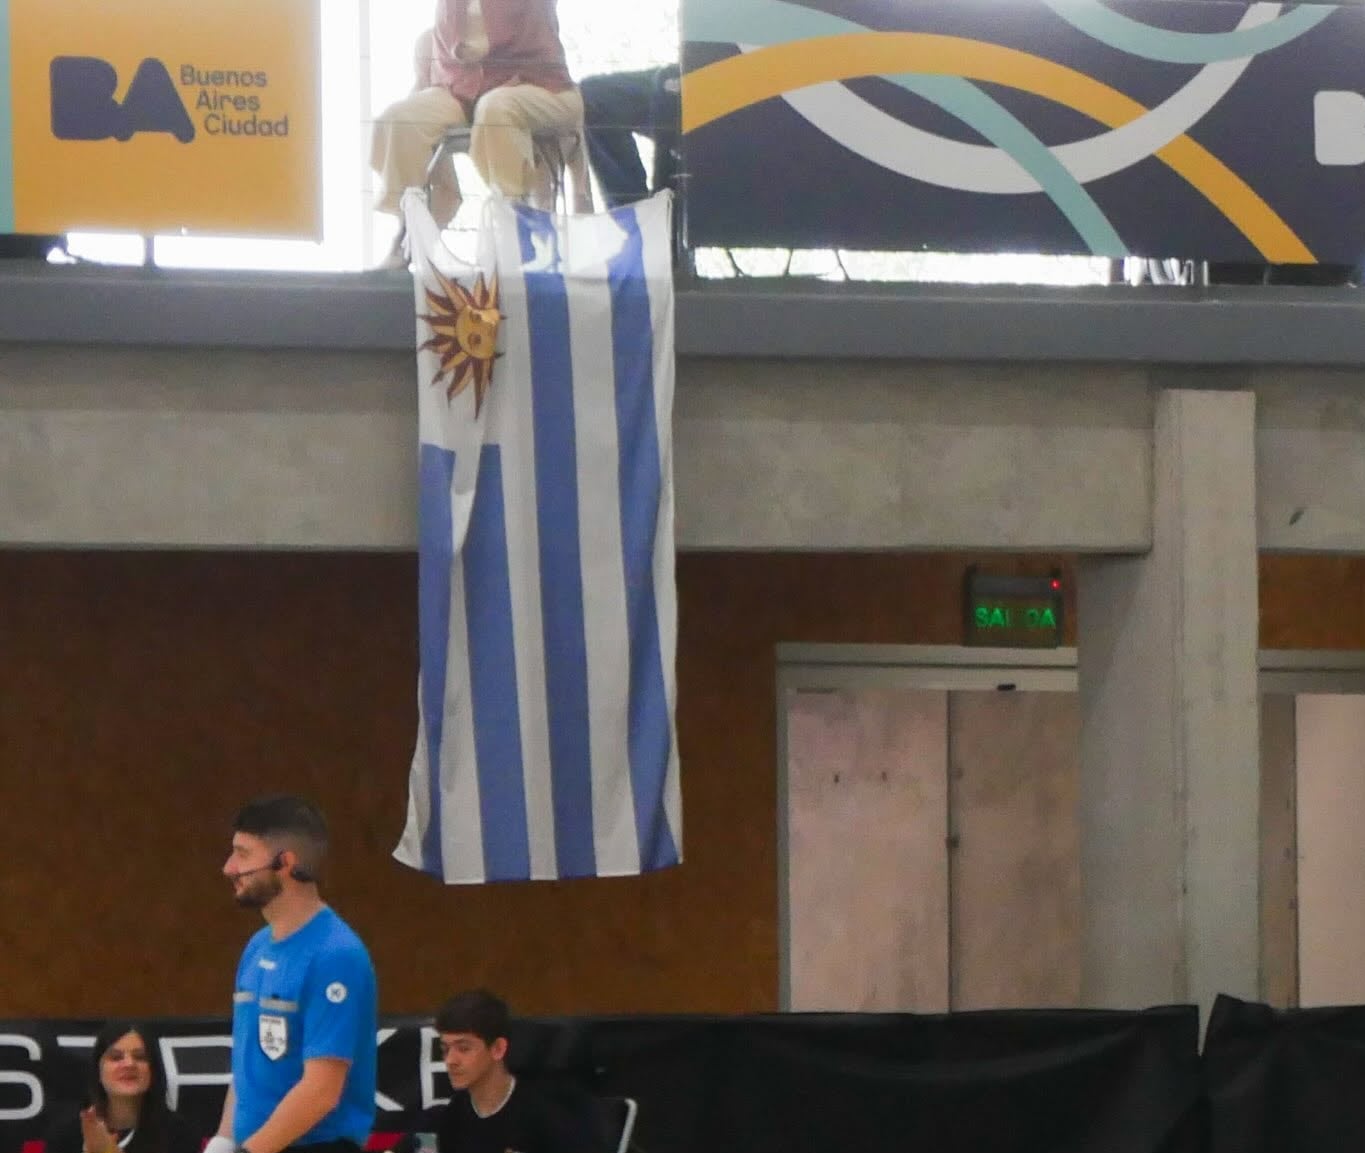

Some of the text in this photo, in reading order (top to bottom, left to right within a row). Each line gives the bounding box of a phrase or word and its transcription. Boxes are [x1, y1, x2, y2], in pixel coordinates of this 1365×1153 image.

[180, 64, 268, 88] Buenos
[49, 55, 196, 144] BA
[195, 89, 261, 112] Aires
[203, 115, 289, 137] Ciudad
